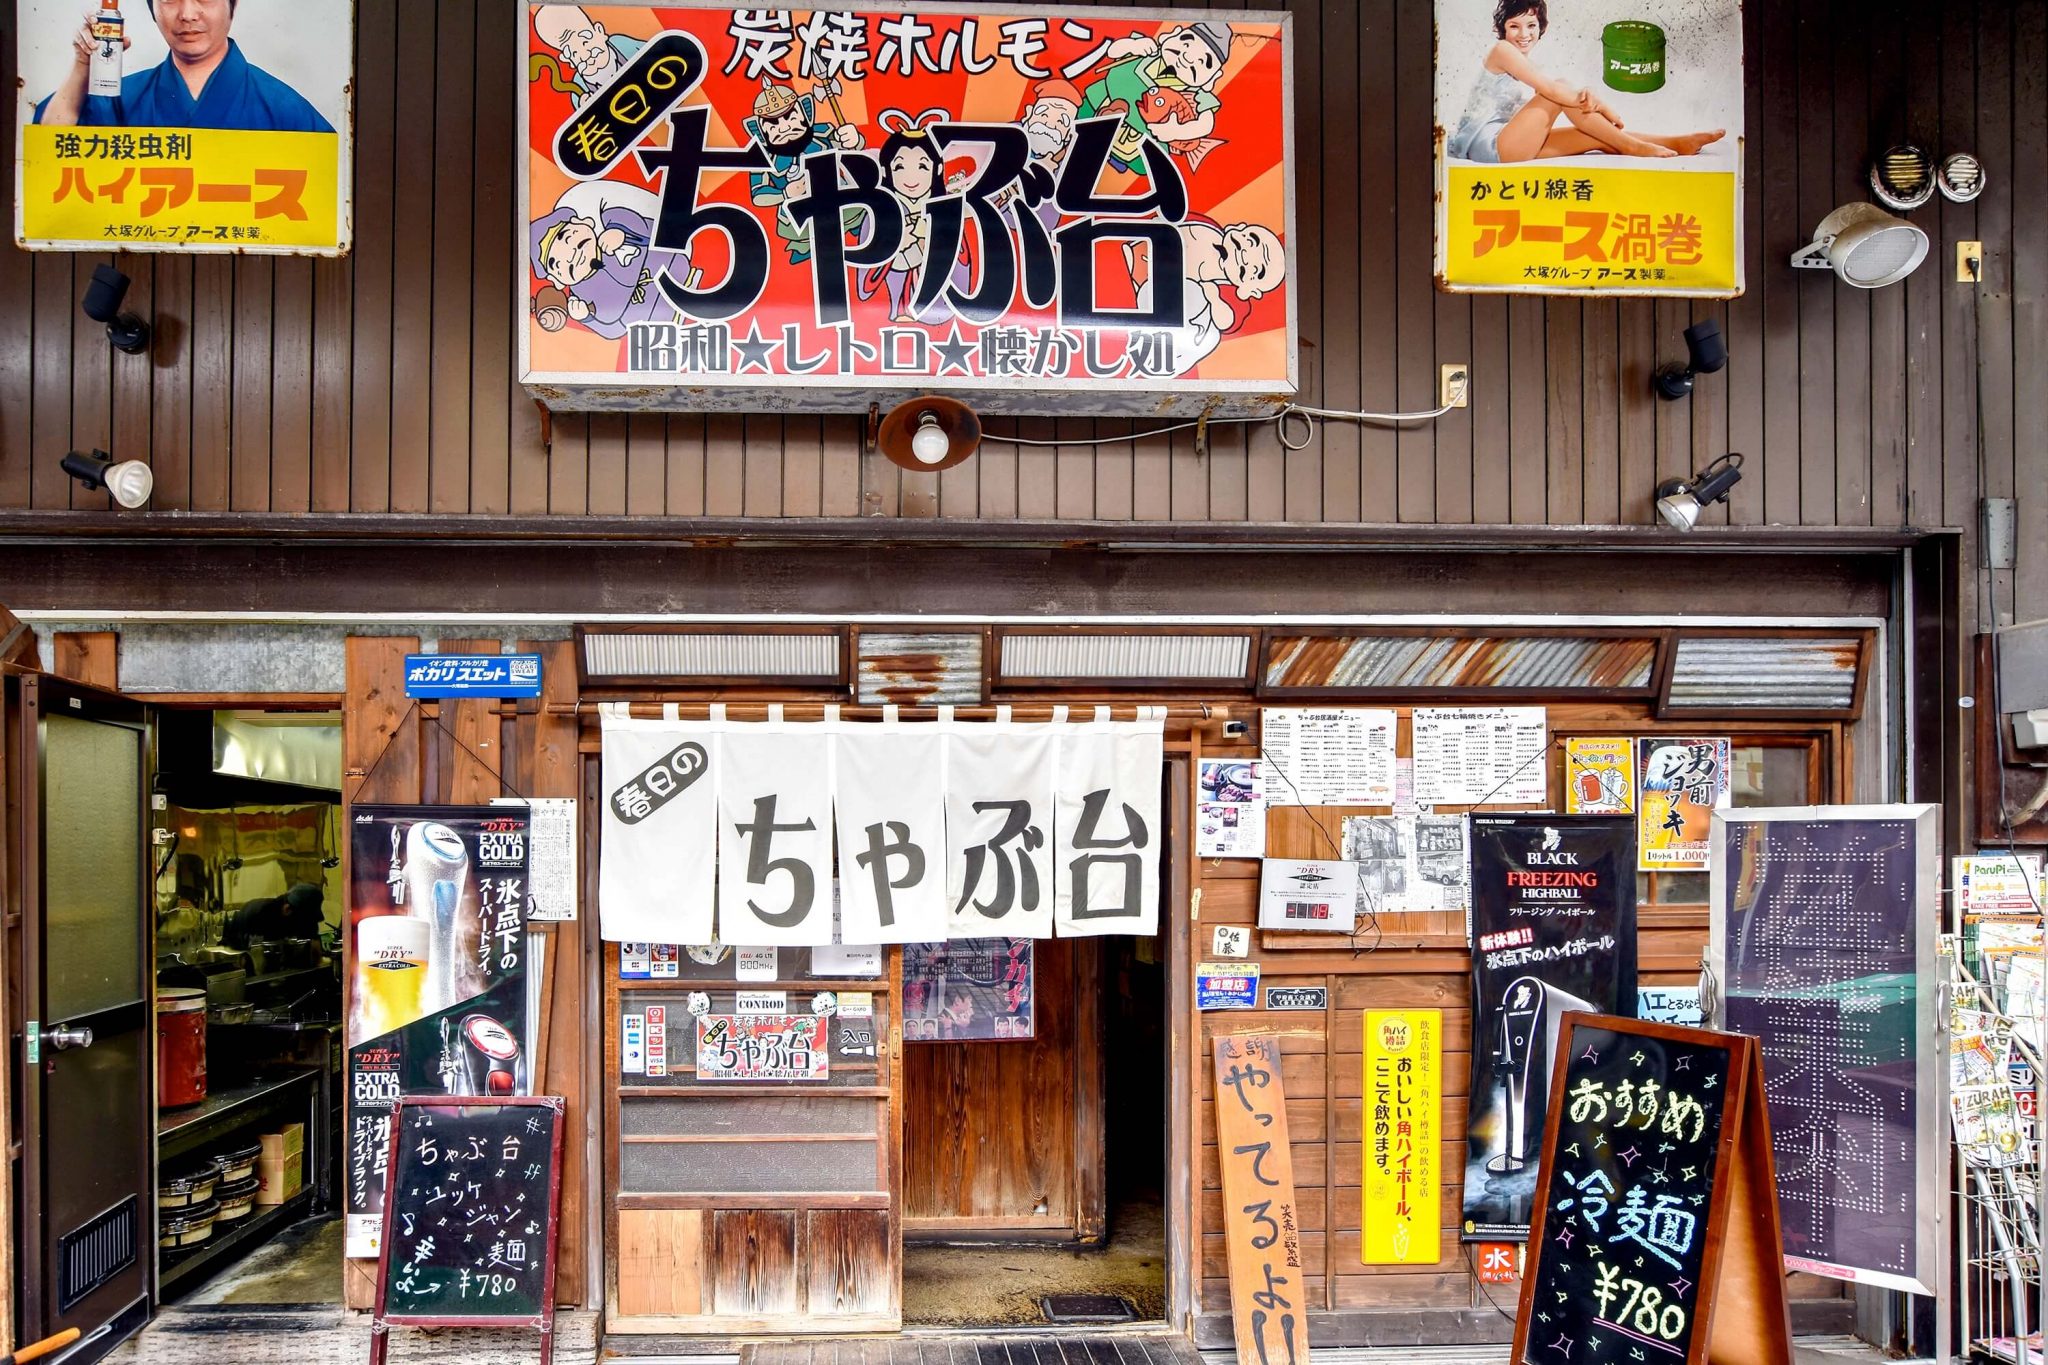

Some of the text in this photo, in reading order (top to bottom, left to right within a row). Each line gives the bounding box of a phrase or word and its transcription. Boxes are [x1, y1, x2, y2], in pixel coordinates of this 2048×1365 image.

[725, 10, 1112, 78] 炭焼ホルモン
[1610, 59, 1660, 75] アース渦巻
[568, 55, 688, 162] 春日の
[55, 133, 192, 160] 強力殺虫剤
[53, 167, 309, 221] ハイアース
[1470, 179, 1594, 201] かとり線香
[635, 105, 1187, 327] ちゃぶ台
[103, 224, 261, 240] 大塚グループ アース製薬
[1473, 209, 1703, 265] アース渦巻
[1524, 266, 1666, 281] 大塚グループ アース製薬
[409, 666, 506, 681] ポカリスエット
[616, 747, 703, 820] 春日の
[1684, 744, 1717, 806] 男前
[1662, 754, 1686, 837] ジョッキ
[480, 834, 523, 845] EXTRA
[479, 845, 523, 860] COLD
[734, 788, 1149, 929] ちゃぶ台
[1526, 852, 1578, 865] BLACK
[1647, 851, 1673, 860] 1リットル
[1507, 871, 1597, 887] FREEZING
[1975, 864, 2006, 875] ParuPi
[1522, 888, 1581, 899] HIGHBALL
[1509, 908, 1596, 916] フリージング ハイボール
[477, 877, 494, 976] スーパードライ。
[496, 878, 522, 969] 氷点下の
[1480, 928, 1533, 949] 新体験!!
[1487, 935, 1615, 969] 氷点下のハイボール
[1209, 980, 1246, 991] 加盟店
[739, 1000, 785, 1009] CONROD
[1383, 1025, 1407, 1035] 角ハイ
[1385, 1036, 1405, 1045] 樽詰
[717, 1032, 810, 1070] ちゃぶ台
[355, 1072, 400, 1084] EXTRA
[355, 1084, 400, 1100] COLD
[1374, 1057, 1391, 1176] ここで飲めます。
[1569, 1078, 1705, 1143] おすすめ
[353, 1115, 367, 1208] ドライブラック。
[466, 1204, 522, 1226] ジャン
[1557, 1168, 1697, 1271] 冷麺
[1483, 1247, 1512, 1270] 水
[459, 1268, 516, 1298] ¥780
[1593, 1261, 1686, 1340] ¥780
